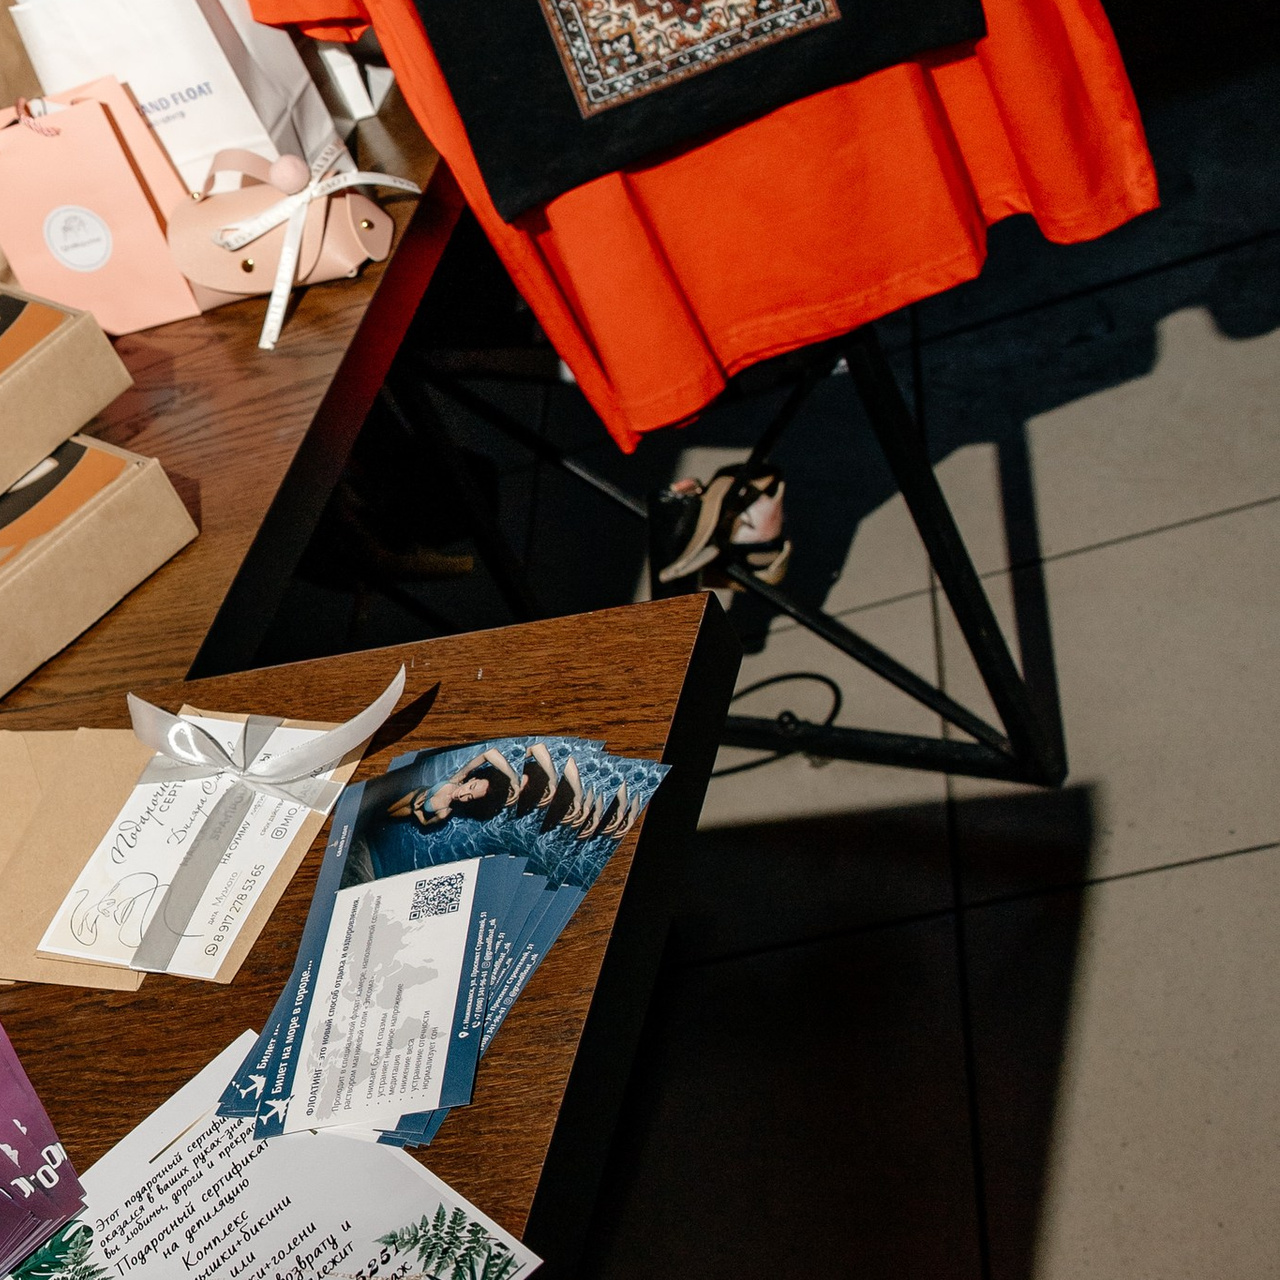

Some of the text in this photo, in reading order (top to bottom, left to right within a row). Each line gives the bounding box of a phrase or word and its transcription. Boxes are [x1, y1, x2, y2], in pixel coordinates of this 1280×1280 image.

[170, 81, 213, 106] FLOAT
[220, 851, 233, 865] НА
[228, 820, 251, 853] СУММУ
[218, 914, 234, 932] 917
[229, 894, 248, 913] 278
[242, 879, 256, 891] 53
[251, 865, 265, 877] 65
[256, 1038, 276, 1069] Билет
[271, 960, 312, 1094] Билет на море в городе...
[306, 1069, 322, 1116] ФЛОАТИНГ
[322, 1018, 333, 1045] новый
[328, 989, 339, 1017] способ
[334, 960, 346, 988] отдыха
[370, 1048, 381, 1066] боли
[377, 1013, 388, 1040] спазмы
[377, 983, 404, 1097] устраняет нервное напряжение
[411, 1011, 430, 1092] устранение отечности
[331, 1076, 345, 1112] Проходит
[342, 1021, 356, 1068] специальной
[344, 1069, 357, 1110] раствором
[352, 1030, 364, 1068] магниевой
[360, 1011, 368, 1028] соли
[366, 1068, 377, 1099] снимает
[389, 1054, 401, 1095] медитация
[400, 1038, 415, 1094] снижение веса
[422, 1042, 437, 1090] нормализует
[96, 1110, 229, 1232] Этот подарочный сертифи
[100, 1116, 244, 1252] оказался в ваших руках-зна
[104, 1245, 120, 1259] вы
[120, 1204, 168, 1244] любимы,
[172, 1170, 203, 1205] дороги
[218, 1123, 261, 1159] прекрас
[114, 1133, 268, 1276] Подарочный сертификат
[163, 1179, 249, 1259] на депиляцию
[182, 1211, 248, 1271] Комплекс
[230, 1252, 256, 1278] или
